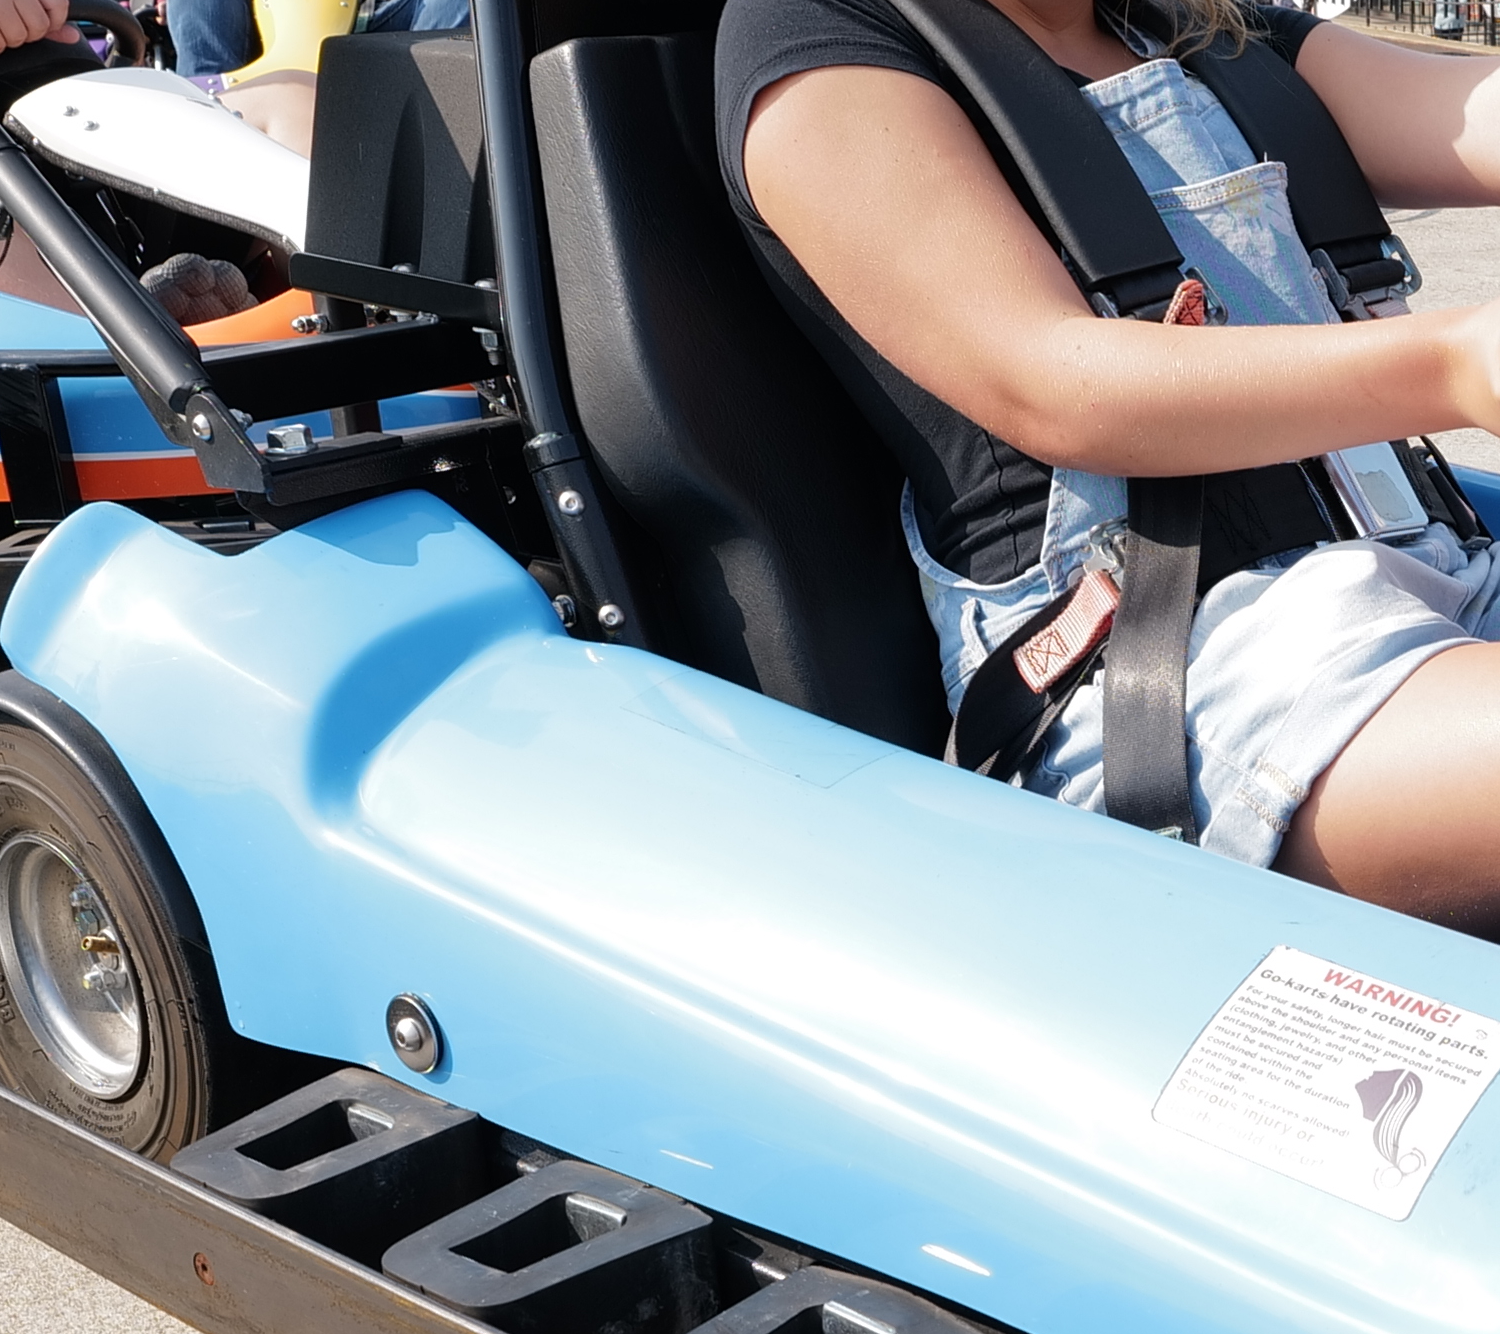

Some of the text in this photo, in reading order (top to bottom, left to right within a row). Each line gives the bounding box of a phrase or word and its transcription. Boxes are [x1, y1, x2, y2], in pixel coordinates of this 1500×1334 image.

[1259, 968, 1487, 1059] Go-karts have rotating parts.
[1323, 968, 1461, 1027] WARNING!
[1206, 1035, 1312, 1079] contained within the
[1214, 1025, 1323, 1070] must be secured and
[1222, 1015, 1343, 1065] entanglement hazards)
[1229, 1004, 1377, 1063] (clothing, jewelry, and other
[1237, 995, 1466, 1084] above the shoulder and any personal items
[1245, 984, 1482, 1076] For your safety, longer hair must be secured
[1199, 1046, 1349, 1109] seating area for the duration
[1205, 1061, 1222, 1072] the
[1176, 1077, 1315, 1142] Serious injury or
[1184, 1067, 1349, 1137] Absolutely no scarves allowed!
